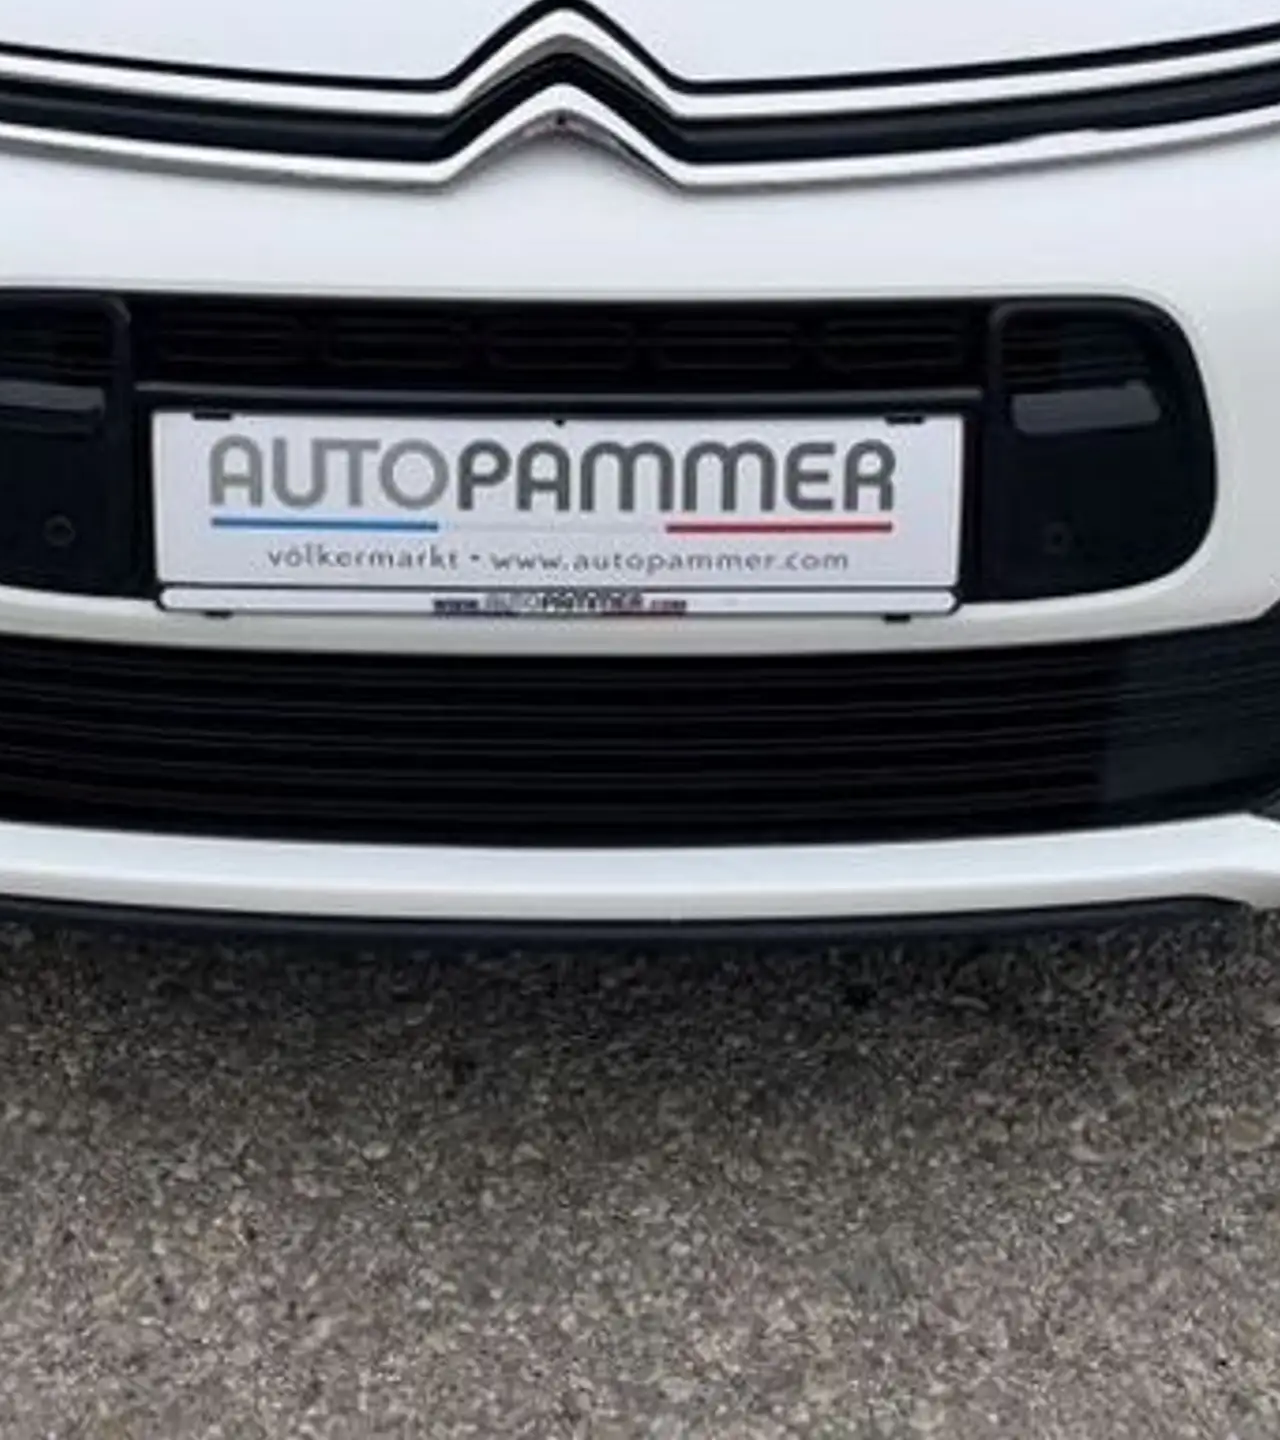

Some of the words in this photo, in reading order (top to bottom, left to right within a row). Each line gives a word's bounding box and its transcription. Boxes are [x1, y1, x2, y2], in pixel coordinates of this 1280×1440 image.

[207, 434, 898, 512] AUTOPAMMER
[267, 543, 460, 570] völkermarkt
[491, 547, 850, 576] www.autopammer.com
